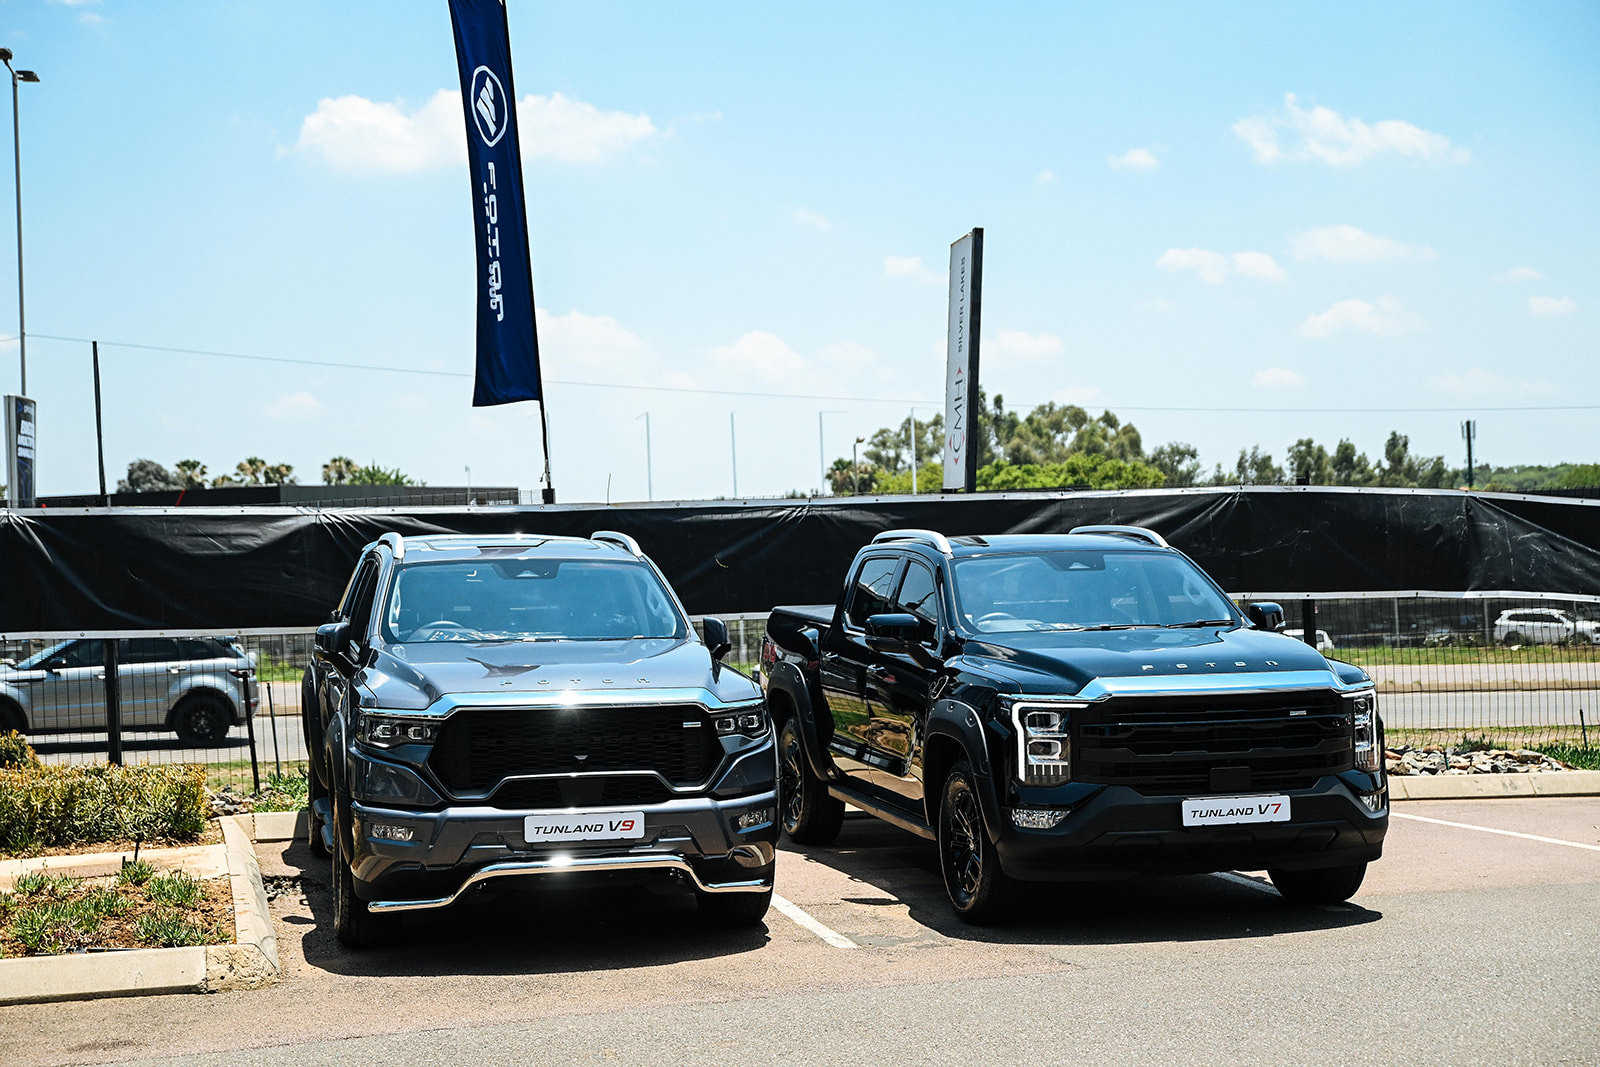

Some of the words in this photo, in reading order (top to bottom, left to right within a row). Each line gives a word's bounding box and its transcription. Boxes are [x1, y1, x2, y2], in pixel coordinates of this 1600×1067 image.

[952, 379, 963, 453] CMH
[1141, 660, 1279, 671] FOTON
[1191, 807, 1254, 818] TUNLAND
[1258, 803, 1282, 815] V7
[534, 824, 604, 835] TUNLAND
[609, 820, 635, 832] V9
